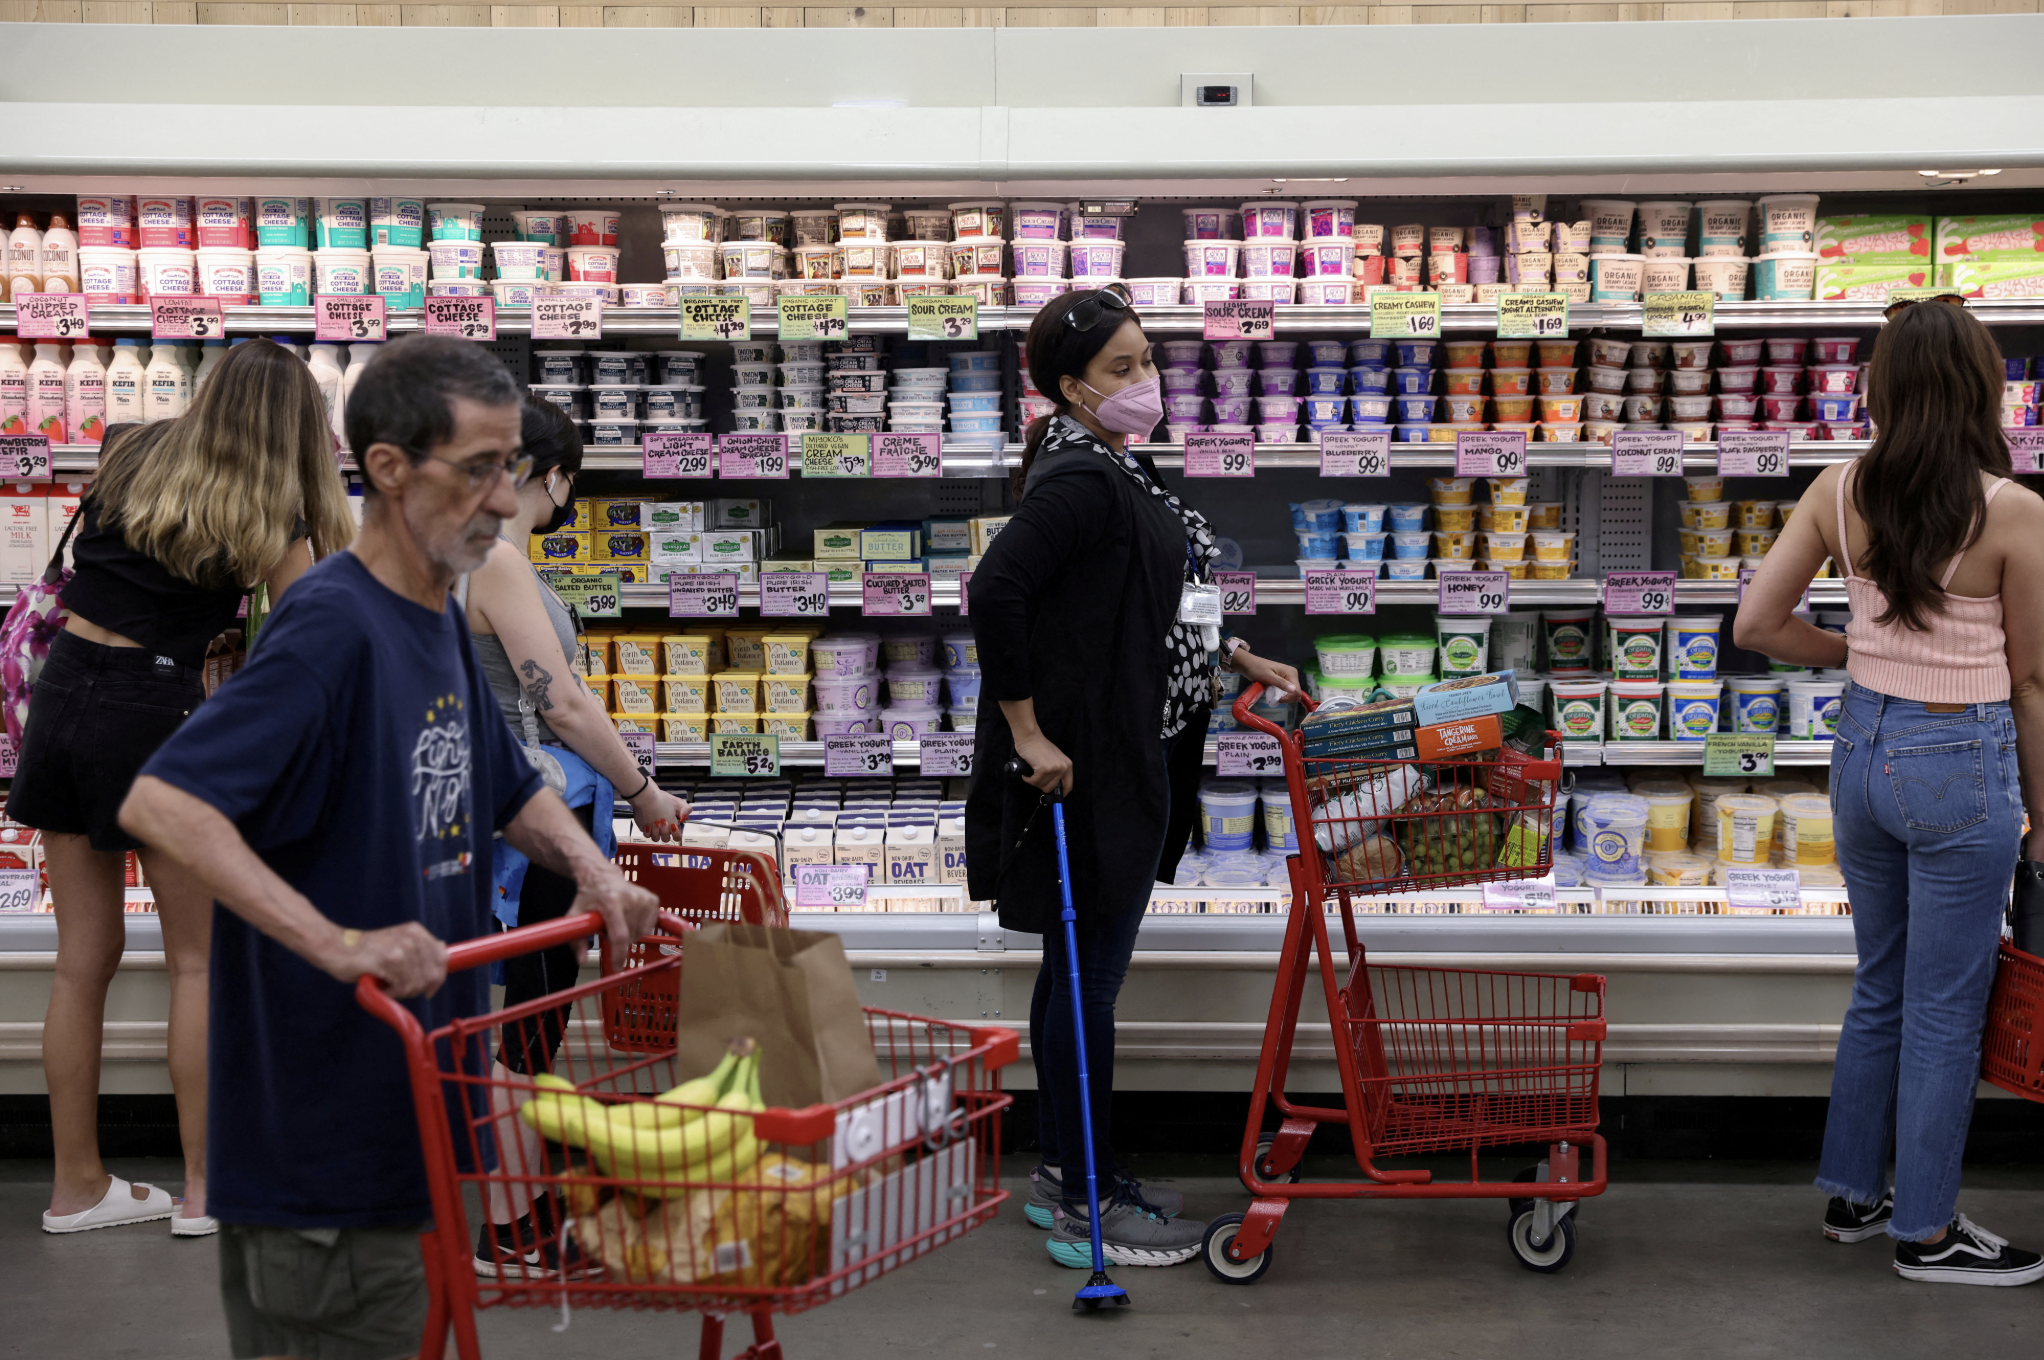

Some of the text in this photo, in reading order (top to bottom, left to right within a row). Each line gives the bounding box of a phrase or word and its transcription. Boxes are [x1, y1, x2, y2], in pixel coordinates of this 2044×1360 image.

[1772, 212, 1806, 220] ORGANIC
[1708, 218, 1742, 226] ORGANIC
[19, 303, 78, 312] WHIPPED
[428, 304, 484, 313] COTTAGE
[536, 303, 592, 312] COTTAGE
[686, 305, 740, 314] COTTAGE
[782, 304, 834, 312] COTTAGE
[911, 304, 974, 315] SOUR CREAM
[1374, 301, 1436, 310] CREAMY CASHEW
[31, 310, 74, 318] CREAM
[158, 306, 206, 315] COTTAGE
[1206, 306, 1272, 318] SOUR CREAM
[156, 315, 190, 324] CHEESE
[329, 312, 364, 320] CHEESE
[437, 313, 480, 322] CHEESE
[540, 313, 581, 321] CHEESE
[693, 314, 734, 322] CHEESE
[786, 313, 829, 321] CHEESE
[1187, 437, 1252, 448] GREEK YOGURT
[648, 450, 680, 458] CREAM
[721, 446, 747, 454] CREAM
[806, 450, 842, 458] CREAM
[1616, 448, 1652, 456] COCONUT
[866, 579, 927, 588] CULTURED SALTED
[1308, 576, 1373, 586] GREEK YOGURT
[1608, 577, 1674, 587] GREEK YOGURT
[1447, 584, 1486, 593] HONEY
[156, 656, 174, 666] ZARA
[1436, 724, 1476, 739] TANGERINE
[828, 740, 892, 750] GREEK YOGURT
[1444, 735, 1467, 746] CREAM
[722, 741, 761, 750] EARTH
[1218, 742, 1248, 751] GREEK
[891, 862, 928, 878] OAT
[802, 873, 830, 885] OAT
[1729, 872, 1796, 882] GREEK YOGURT
